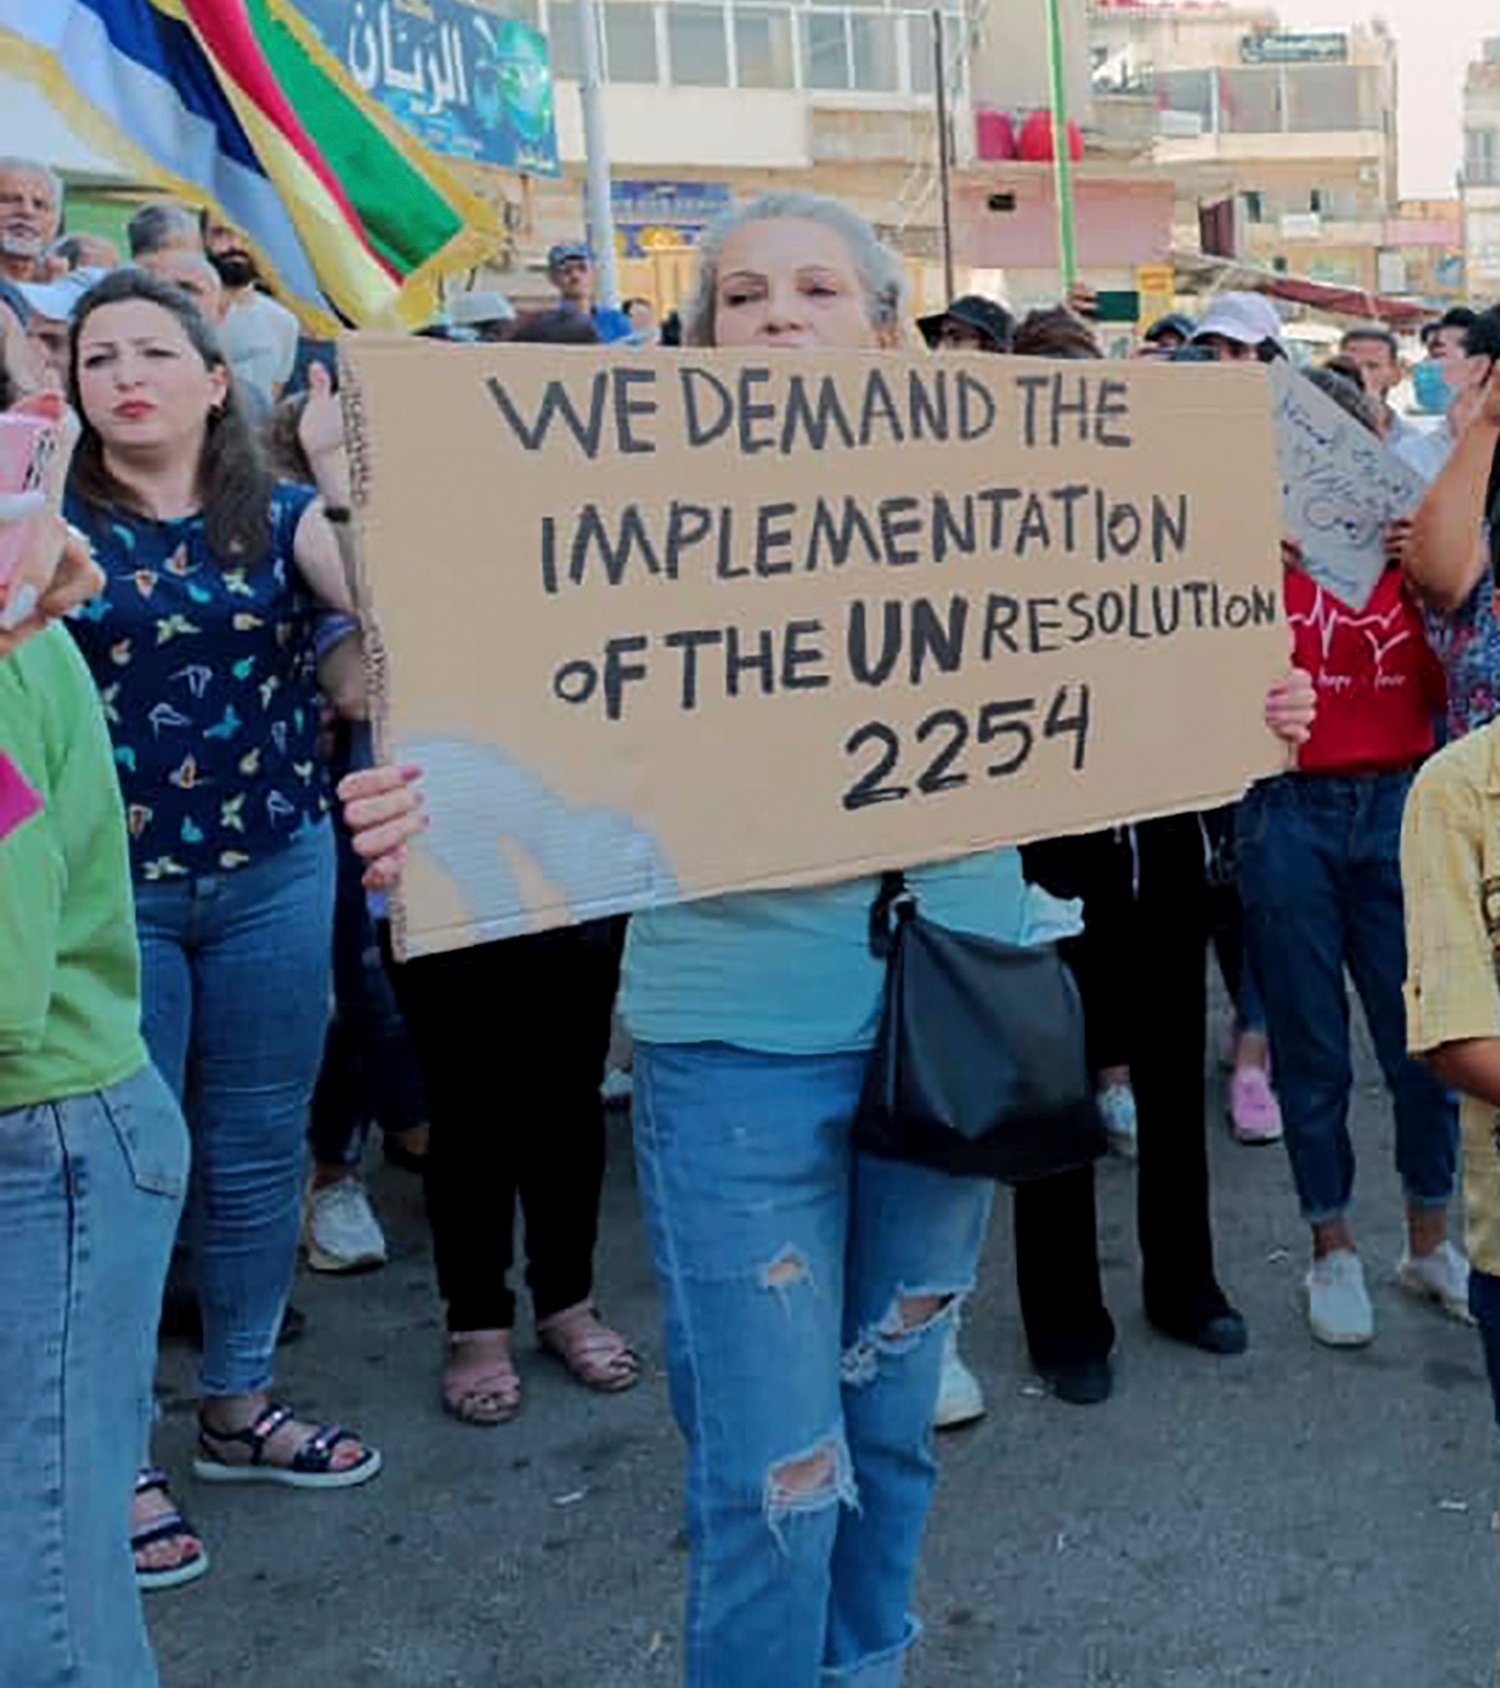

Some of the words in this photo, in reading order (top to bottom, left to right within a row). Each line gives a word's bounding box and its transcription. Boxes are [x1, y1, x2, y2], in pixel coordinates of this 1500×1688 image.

[488, 369, 657, 455] WE
[683, 371, 992, 451] DEMAND
[1018, 375, 1130, 447] THE
[542, 485, 1188, 590] IMPLEMENTATION
[666, 619, 829, 709] THE
[849, 597, 967, 686] UN
[984, 582, 1276, 660] RESOLUTION
[842, 684, 1091, 810] 2254
